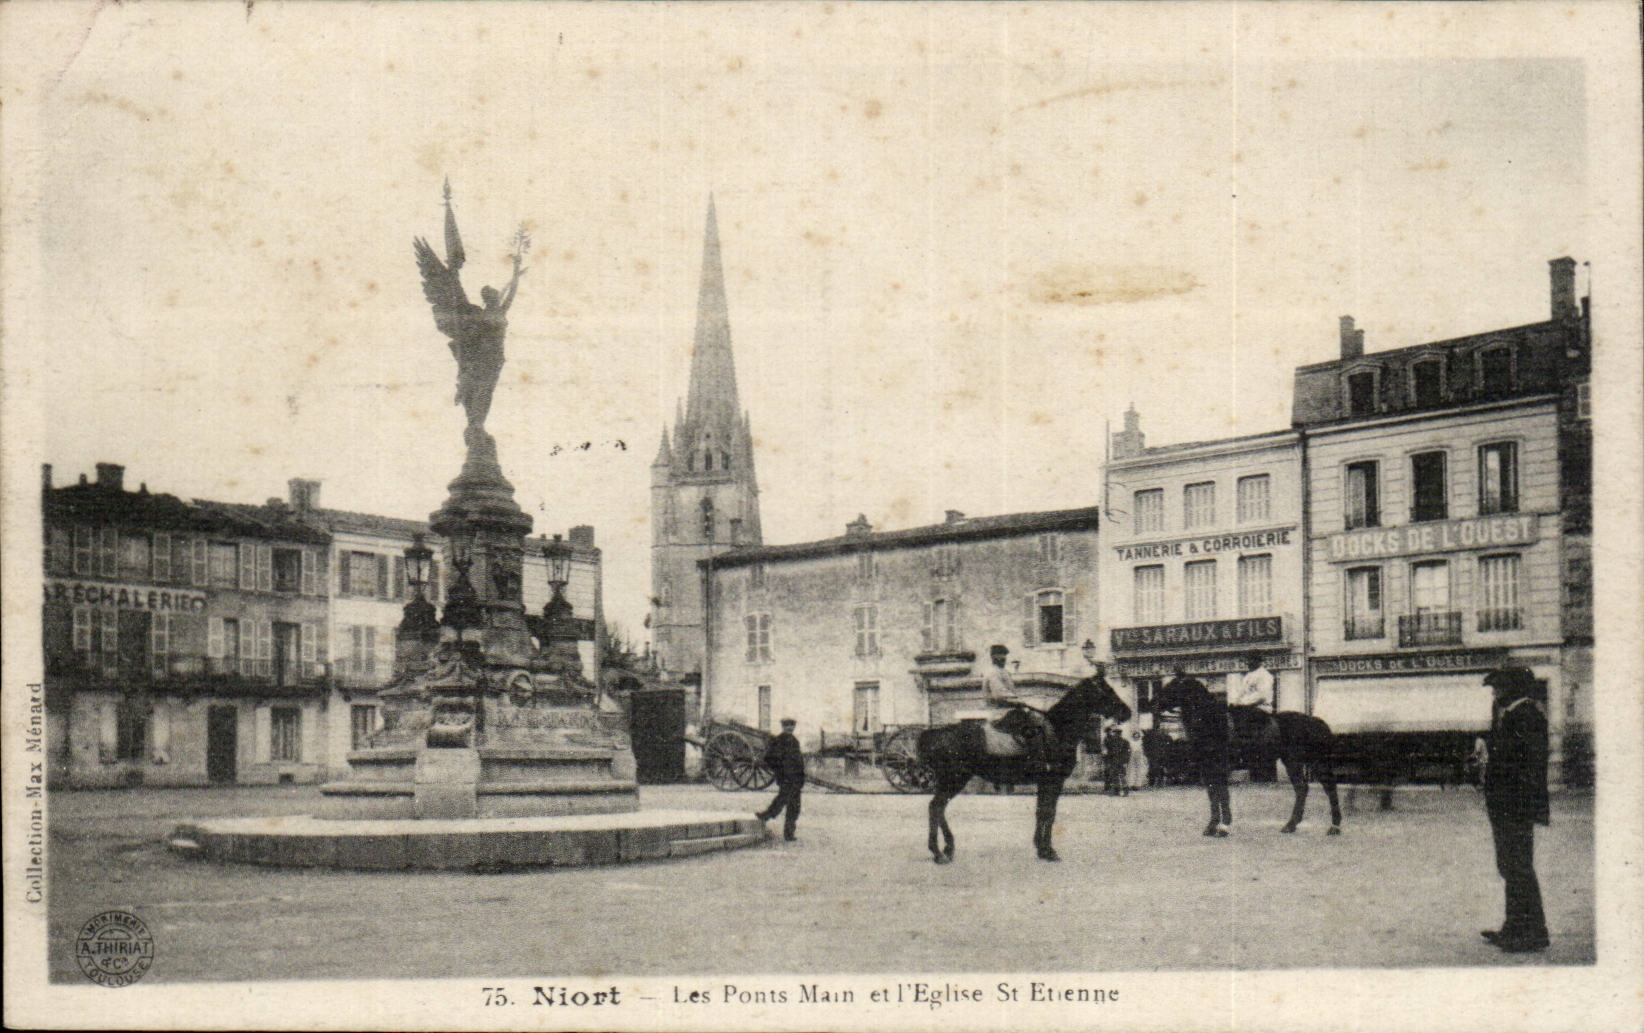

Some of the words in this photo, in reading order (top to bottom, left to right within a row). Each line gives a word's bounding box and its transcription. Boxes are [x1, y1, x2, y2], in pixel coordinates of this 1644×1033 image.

[1117, 543, 1183, 562] TANNERIE
[1189, 542, 1199, 554] &
[1203, 530, 1291, 553] CORROIERIE
[1331, 531, 1400, 559] DOCKS
[1407, 527, 1435, 551] DE
[1442, 516, 1532, 547] L'OUEST
[1236, 618, 1278, 638] FILS
[1338, 658, 1383, 672] DOCKS
